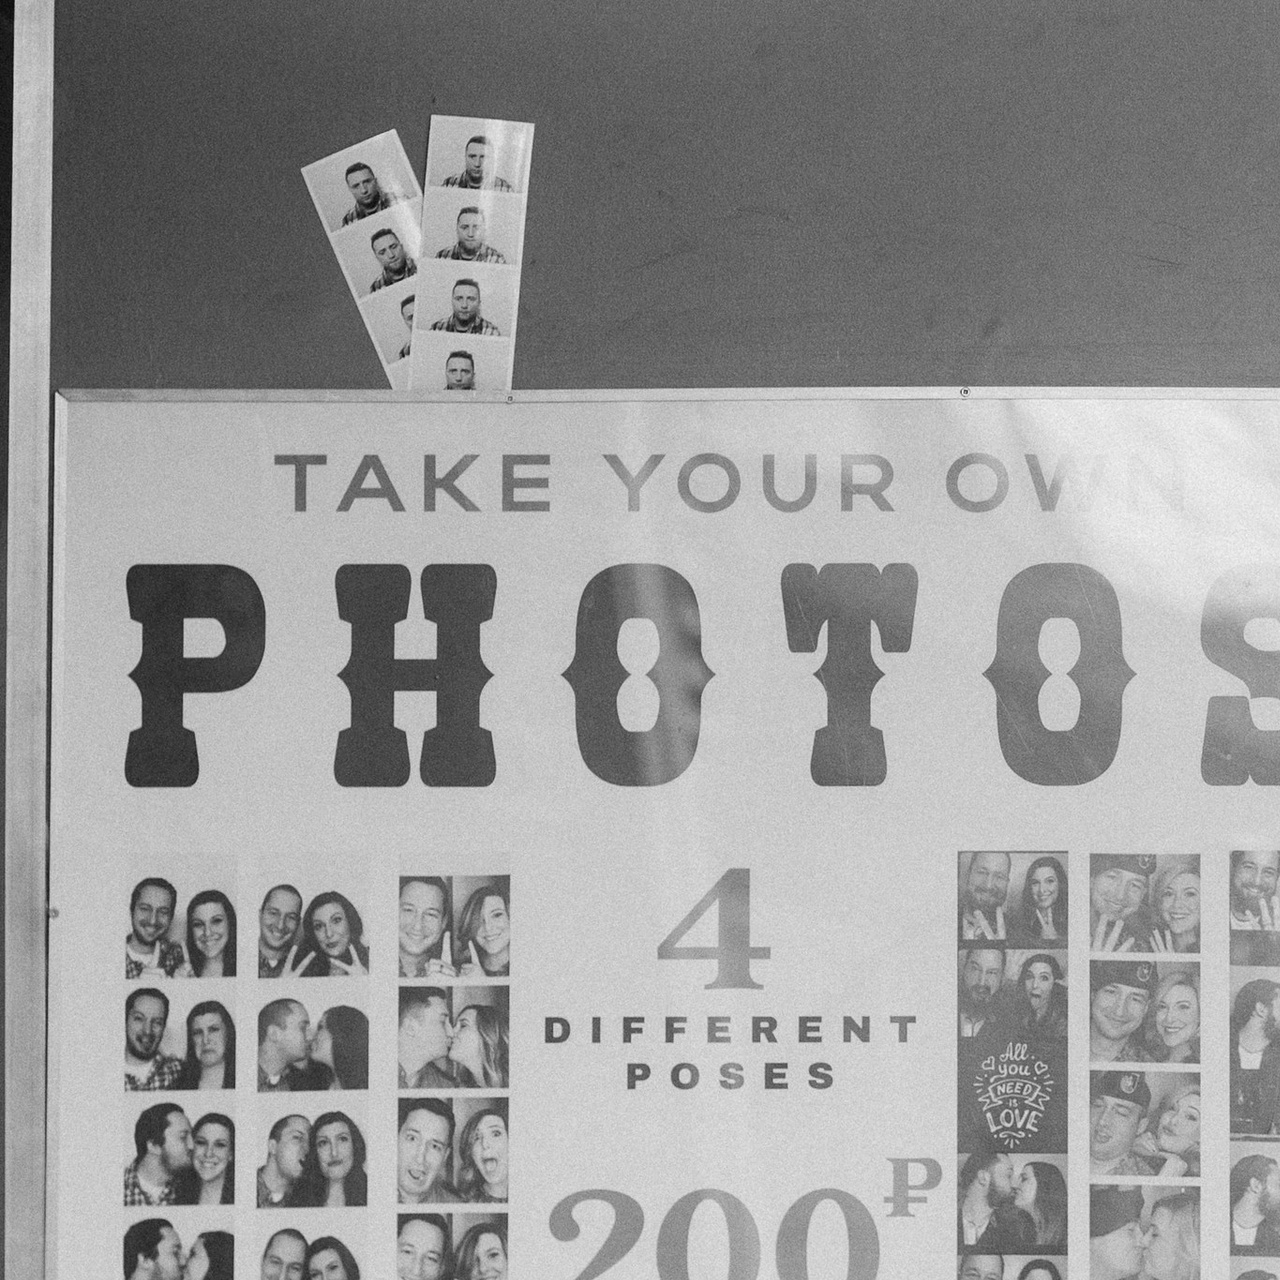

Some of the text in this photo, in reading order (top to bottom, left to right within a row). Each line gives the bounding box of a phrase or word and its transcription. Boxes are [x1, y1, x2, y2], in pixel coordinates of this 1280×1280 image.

[274, 453, 551, 513] TAKE
[602, 453, 895, 514] YOUR
[657, 867, 771, 990] 4
[544, 1016, 917, 1044] DIFFERENT
[999, 1042, 1028, 1062] All
[626, 1062, 834, 1090] POSES
[990, 1064, 1030, 1083] you
[997, 1082, 1032, 1095] NEED
[986, 1108, 1043, 1133] LOVE
